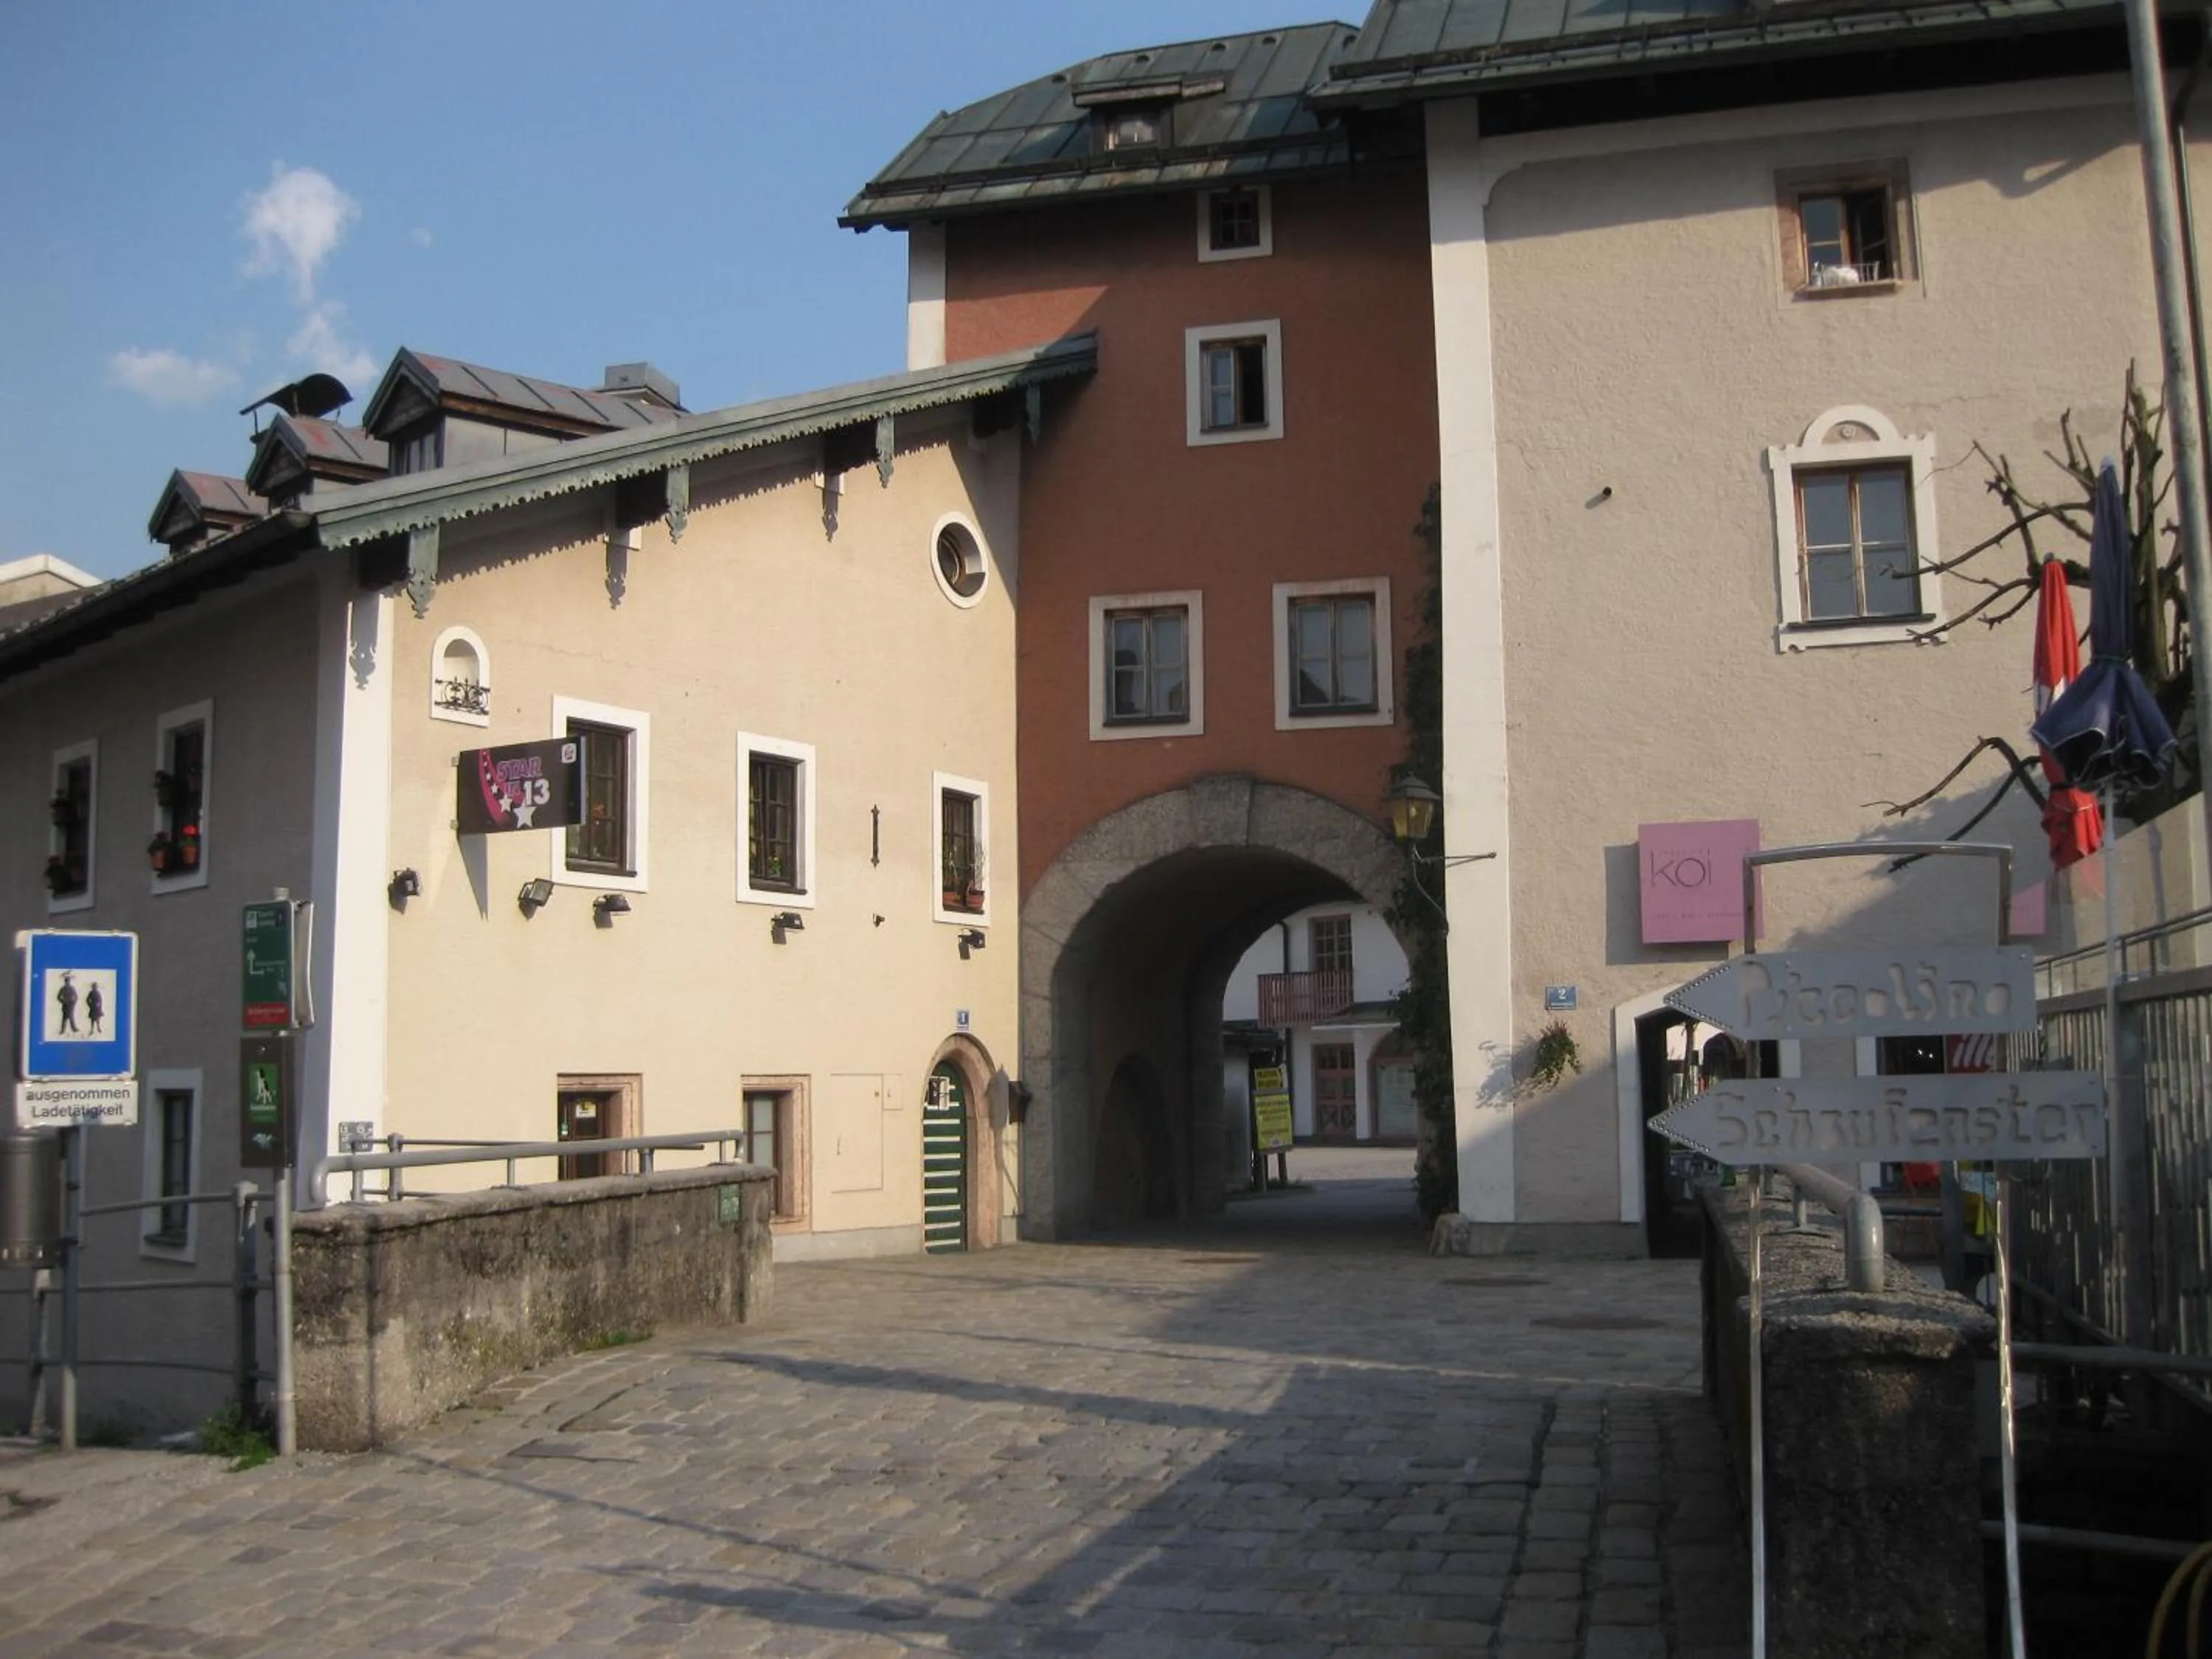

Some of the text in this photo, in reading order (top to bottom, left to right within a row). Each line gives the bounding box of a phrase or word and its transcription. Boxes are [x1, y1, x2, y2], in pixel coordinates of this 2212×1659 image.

[497, 757, 543, 782] STAR
[524, 779, 550, 805] 13
[1558, 988, 1567, 1000] 2
[26, 1088, 131, 1102] ausgenommen
[32, 1105, 124, 1119] Ladetätigkeit
[1714, 1085, 2098, 1149] Schaufenster
